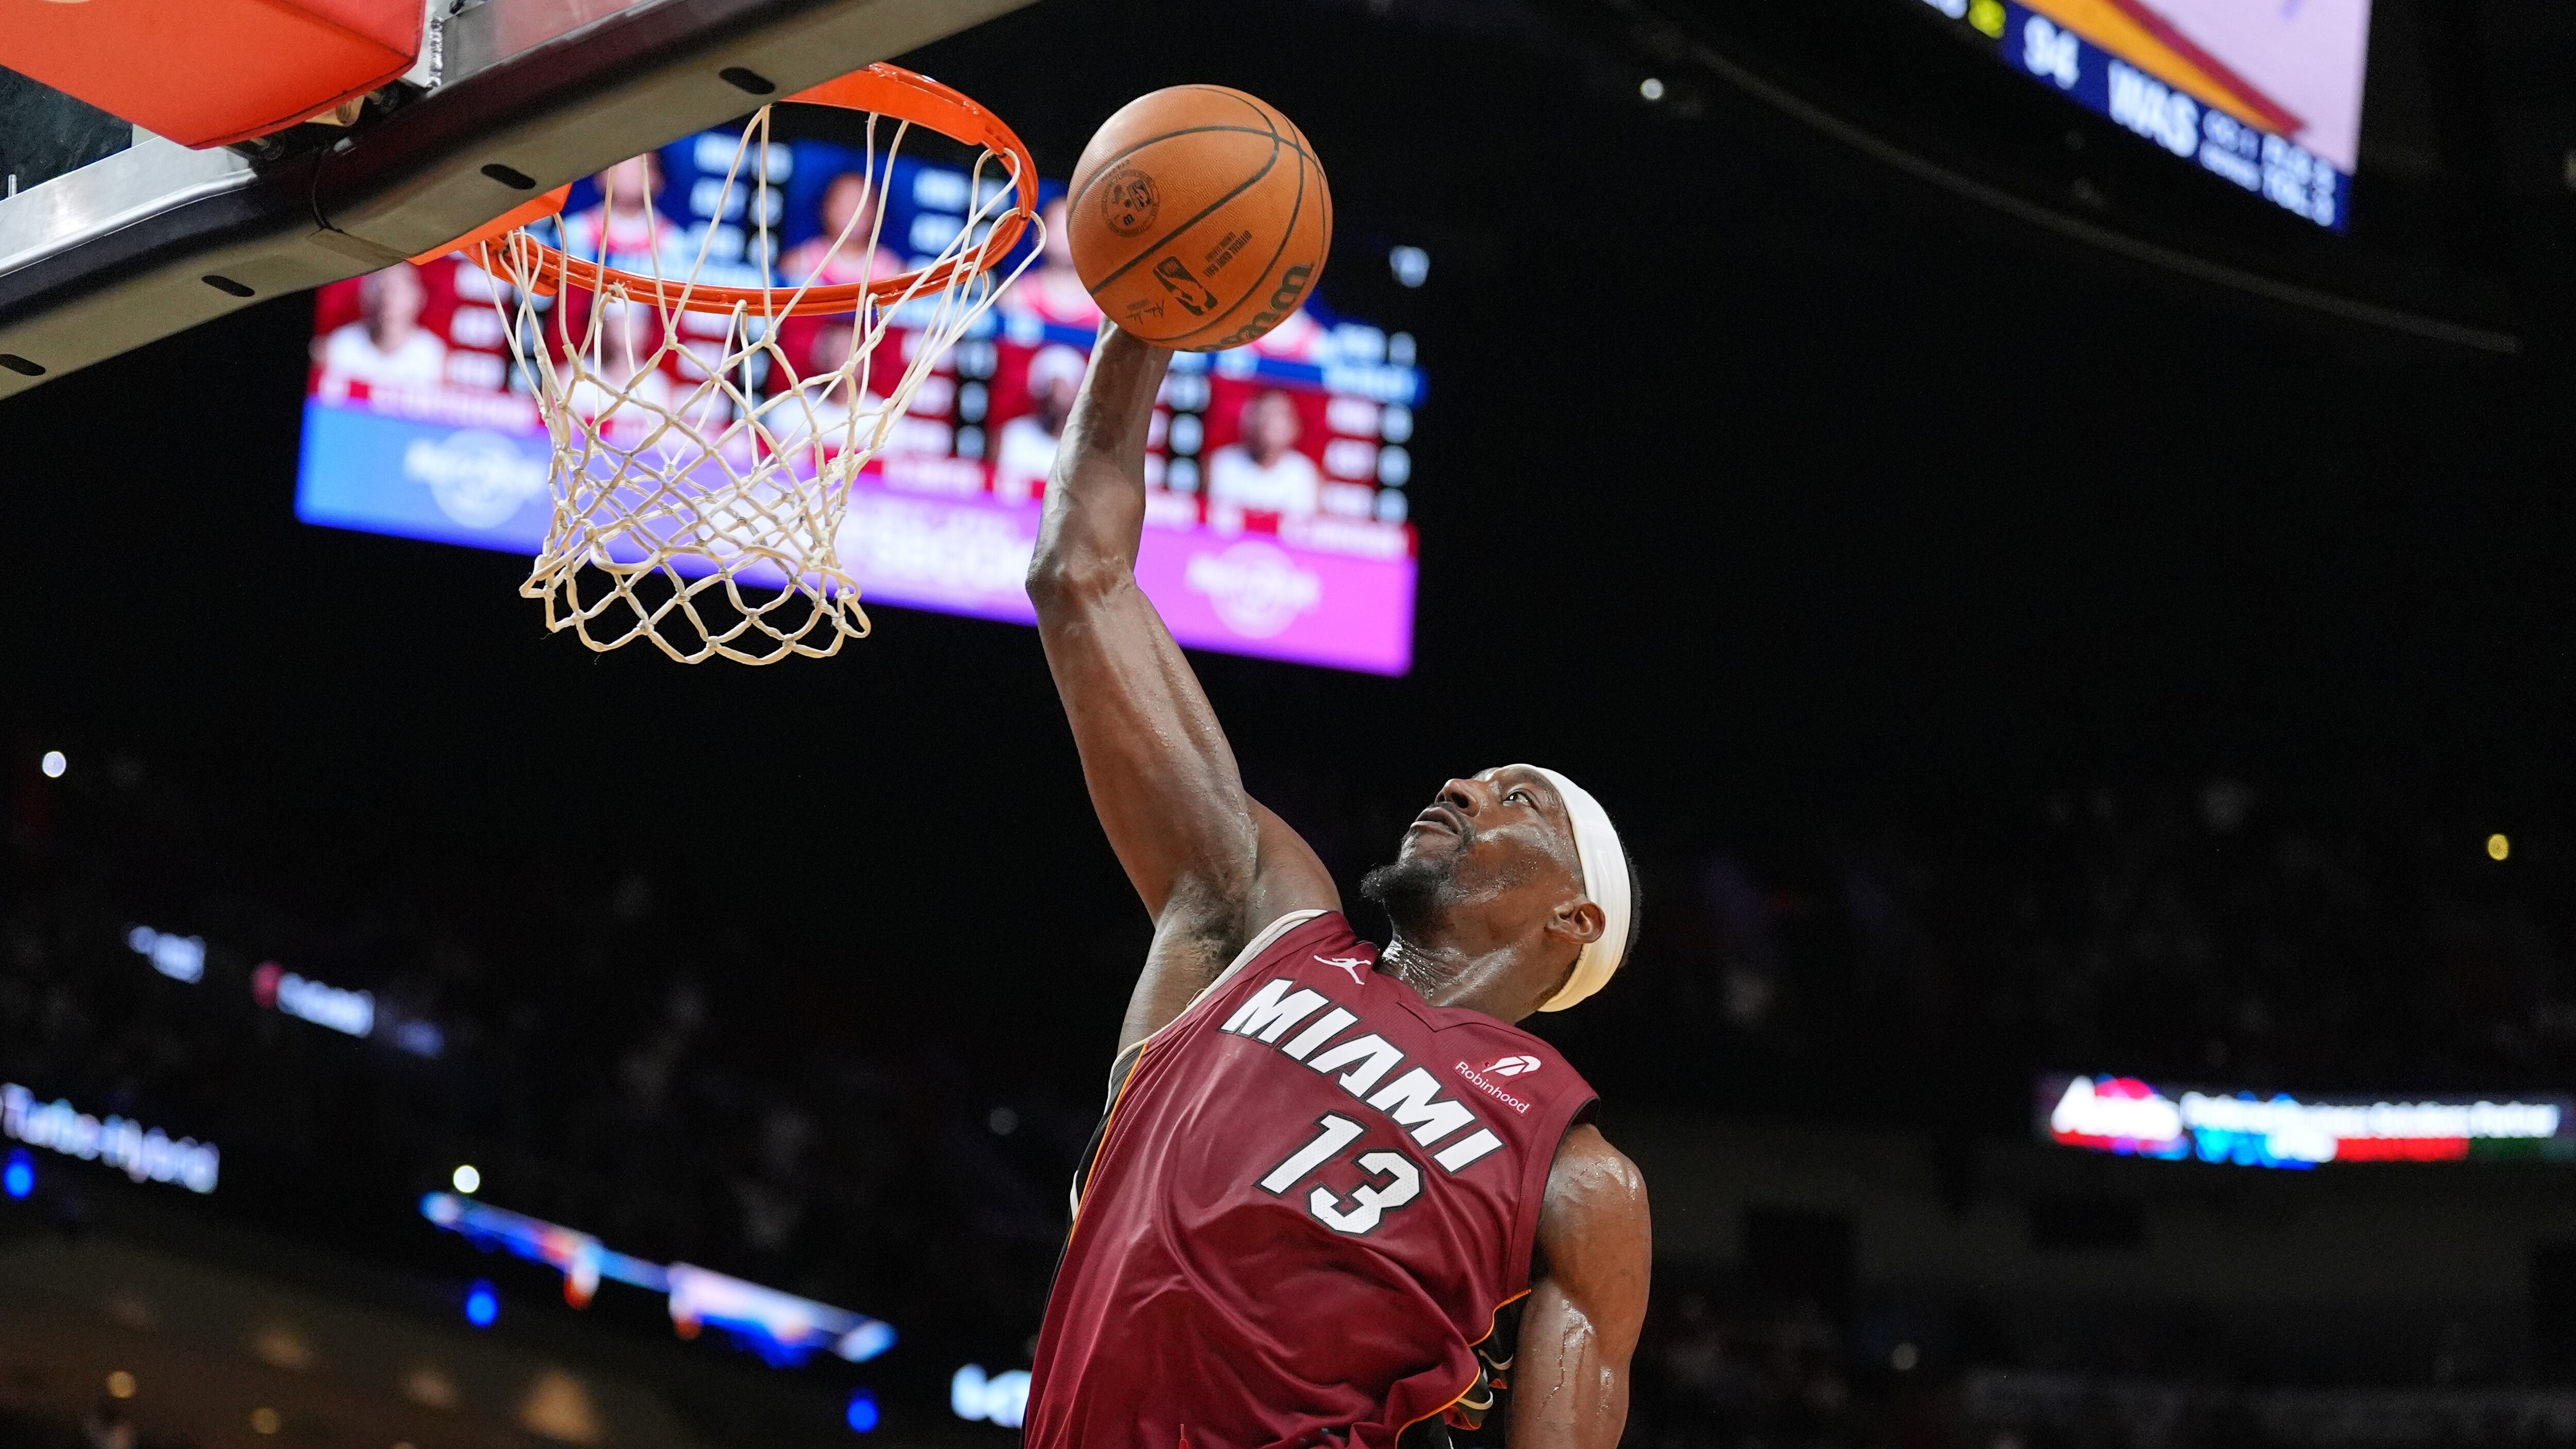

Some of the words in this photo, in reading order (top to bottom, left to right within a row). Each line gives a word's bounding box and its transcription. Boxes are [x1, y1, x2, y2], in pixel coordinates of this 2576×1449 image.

[2107, 59, 2199, 157] WAS
[1218, 978, 1506, 1174] MIAMI
[1454, 1060, 1531, 1115] Robinhood
[1253, 1110, 1425, 1236] 13
